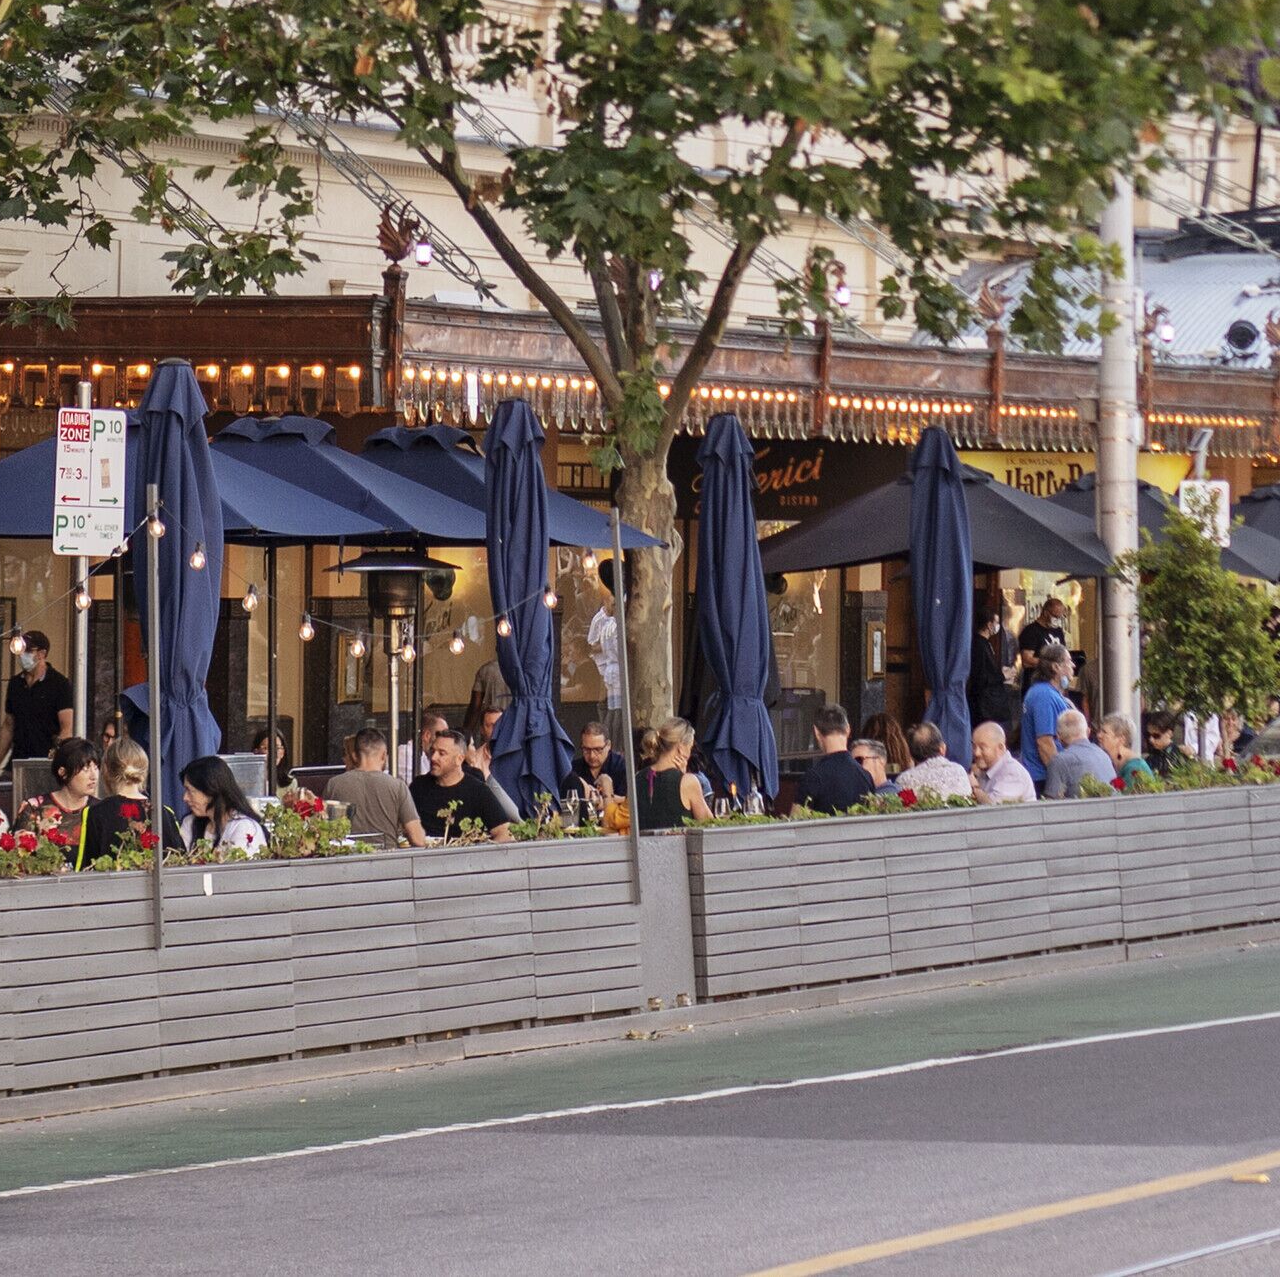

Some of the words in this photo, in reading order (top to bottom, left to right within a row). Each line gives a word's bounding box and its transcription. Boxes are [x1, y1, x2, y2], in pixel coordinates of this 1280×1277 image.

[61, 412, 90, 426] LOADING
[61, 427, 91, 441] ZONE
[93, 419, 106, 441] P
[109, 420, 122, 434] 10
[56, 514, 69, 537] P
[72, 515, 86, 529] 10
